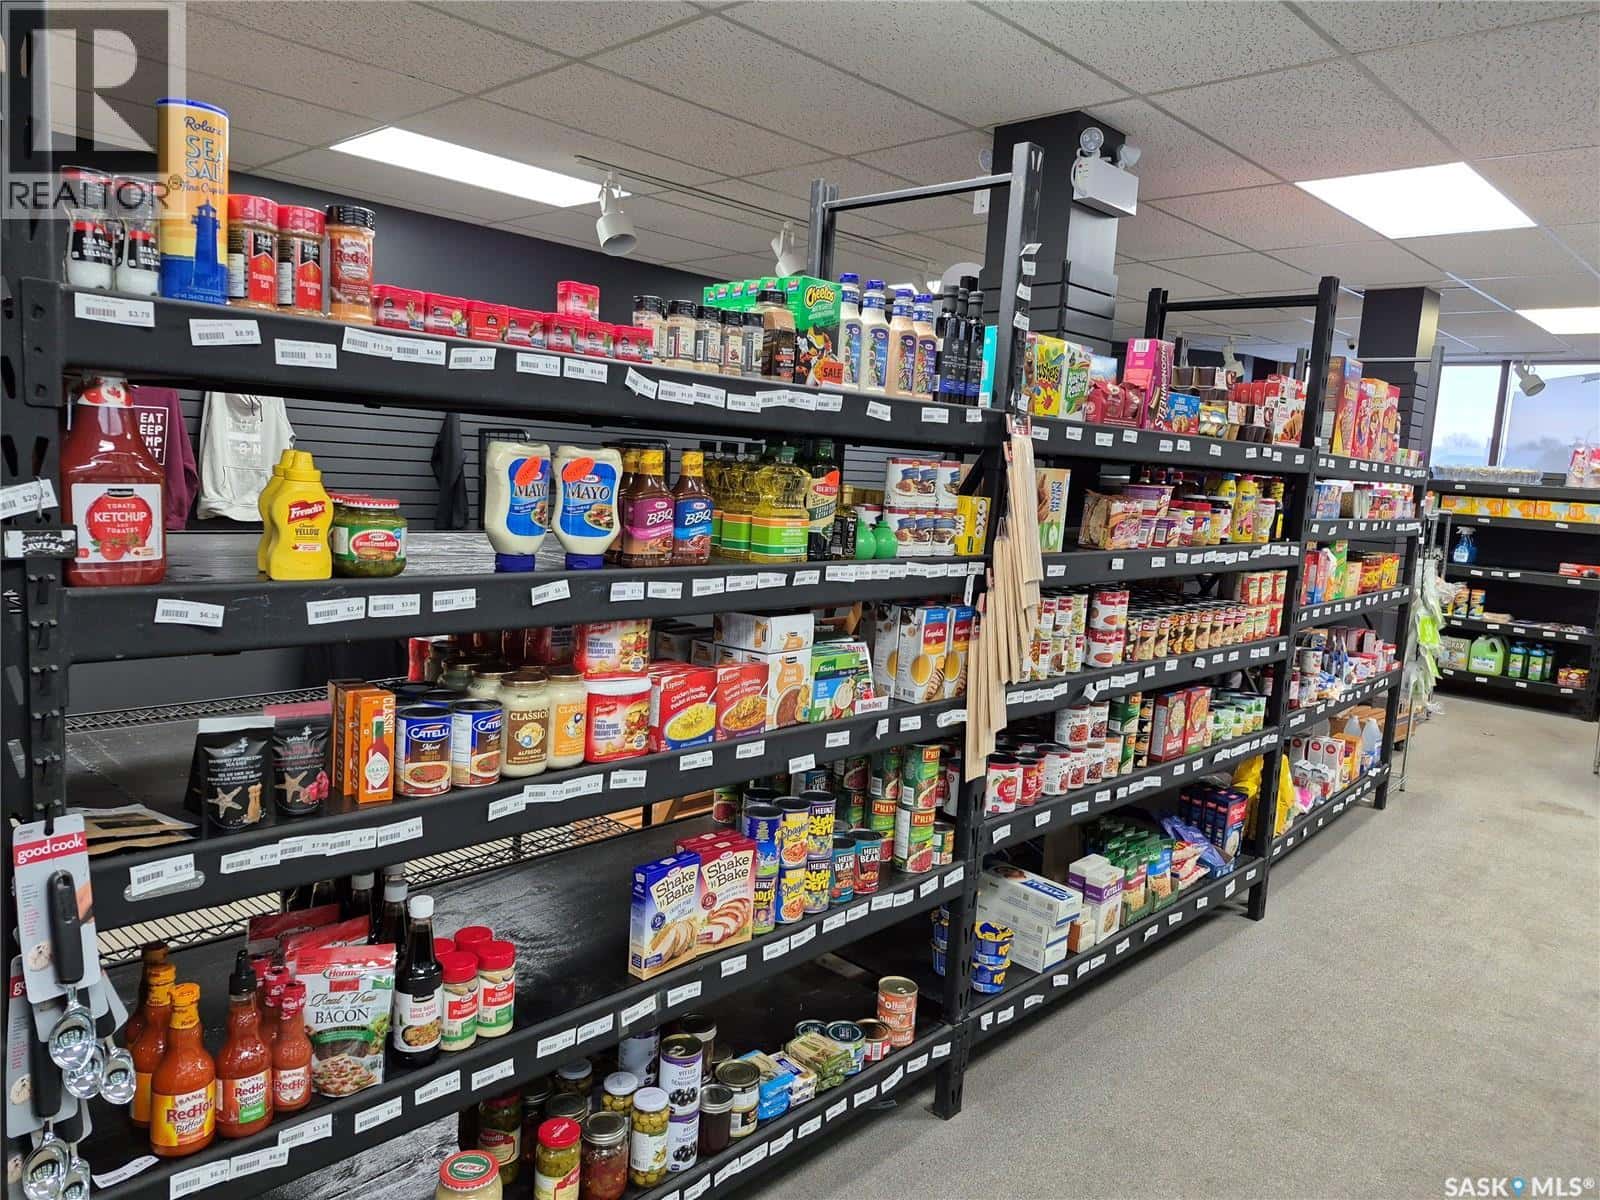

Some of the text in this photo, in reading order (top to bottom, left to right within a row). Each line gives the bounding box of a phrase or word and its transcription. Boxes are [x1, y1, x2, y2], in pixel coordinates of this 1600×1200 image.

[823, 366, 844, 378] SALE
[139, 412, 164, 424] EAT
[138, 424, 164, 435] EEP
[94, 511, 148, 523] KETCHUP
[646, 508, 673, 527] BBQ
[684, 508, 712, 527] BBQ
[295, 527, 320, 536] YELLOW
[511, 710, 549, 721] CLASSIC
[874, 803, 897, 812] PRIM
[914, 814, 935, 823] PRIM
[17, 834, 84, 864] good cook
[860, 854, 880, 863] BEAN
[706, 854, 750, 880] Shake
[655, 869, 696, 899] Shake
[717, 867, 749, 889] Bake
[755, 880, 772, 889] EINZ
[664, 882, 695, 907] Bake
[315, 1007, 371, 1024] BACON
